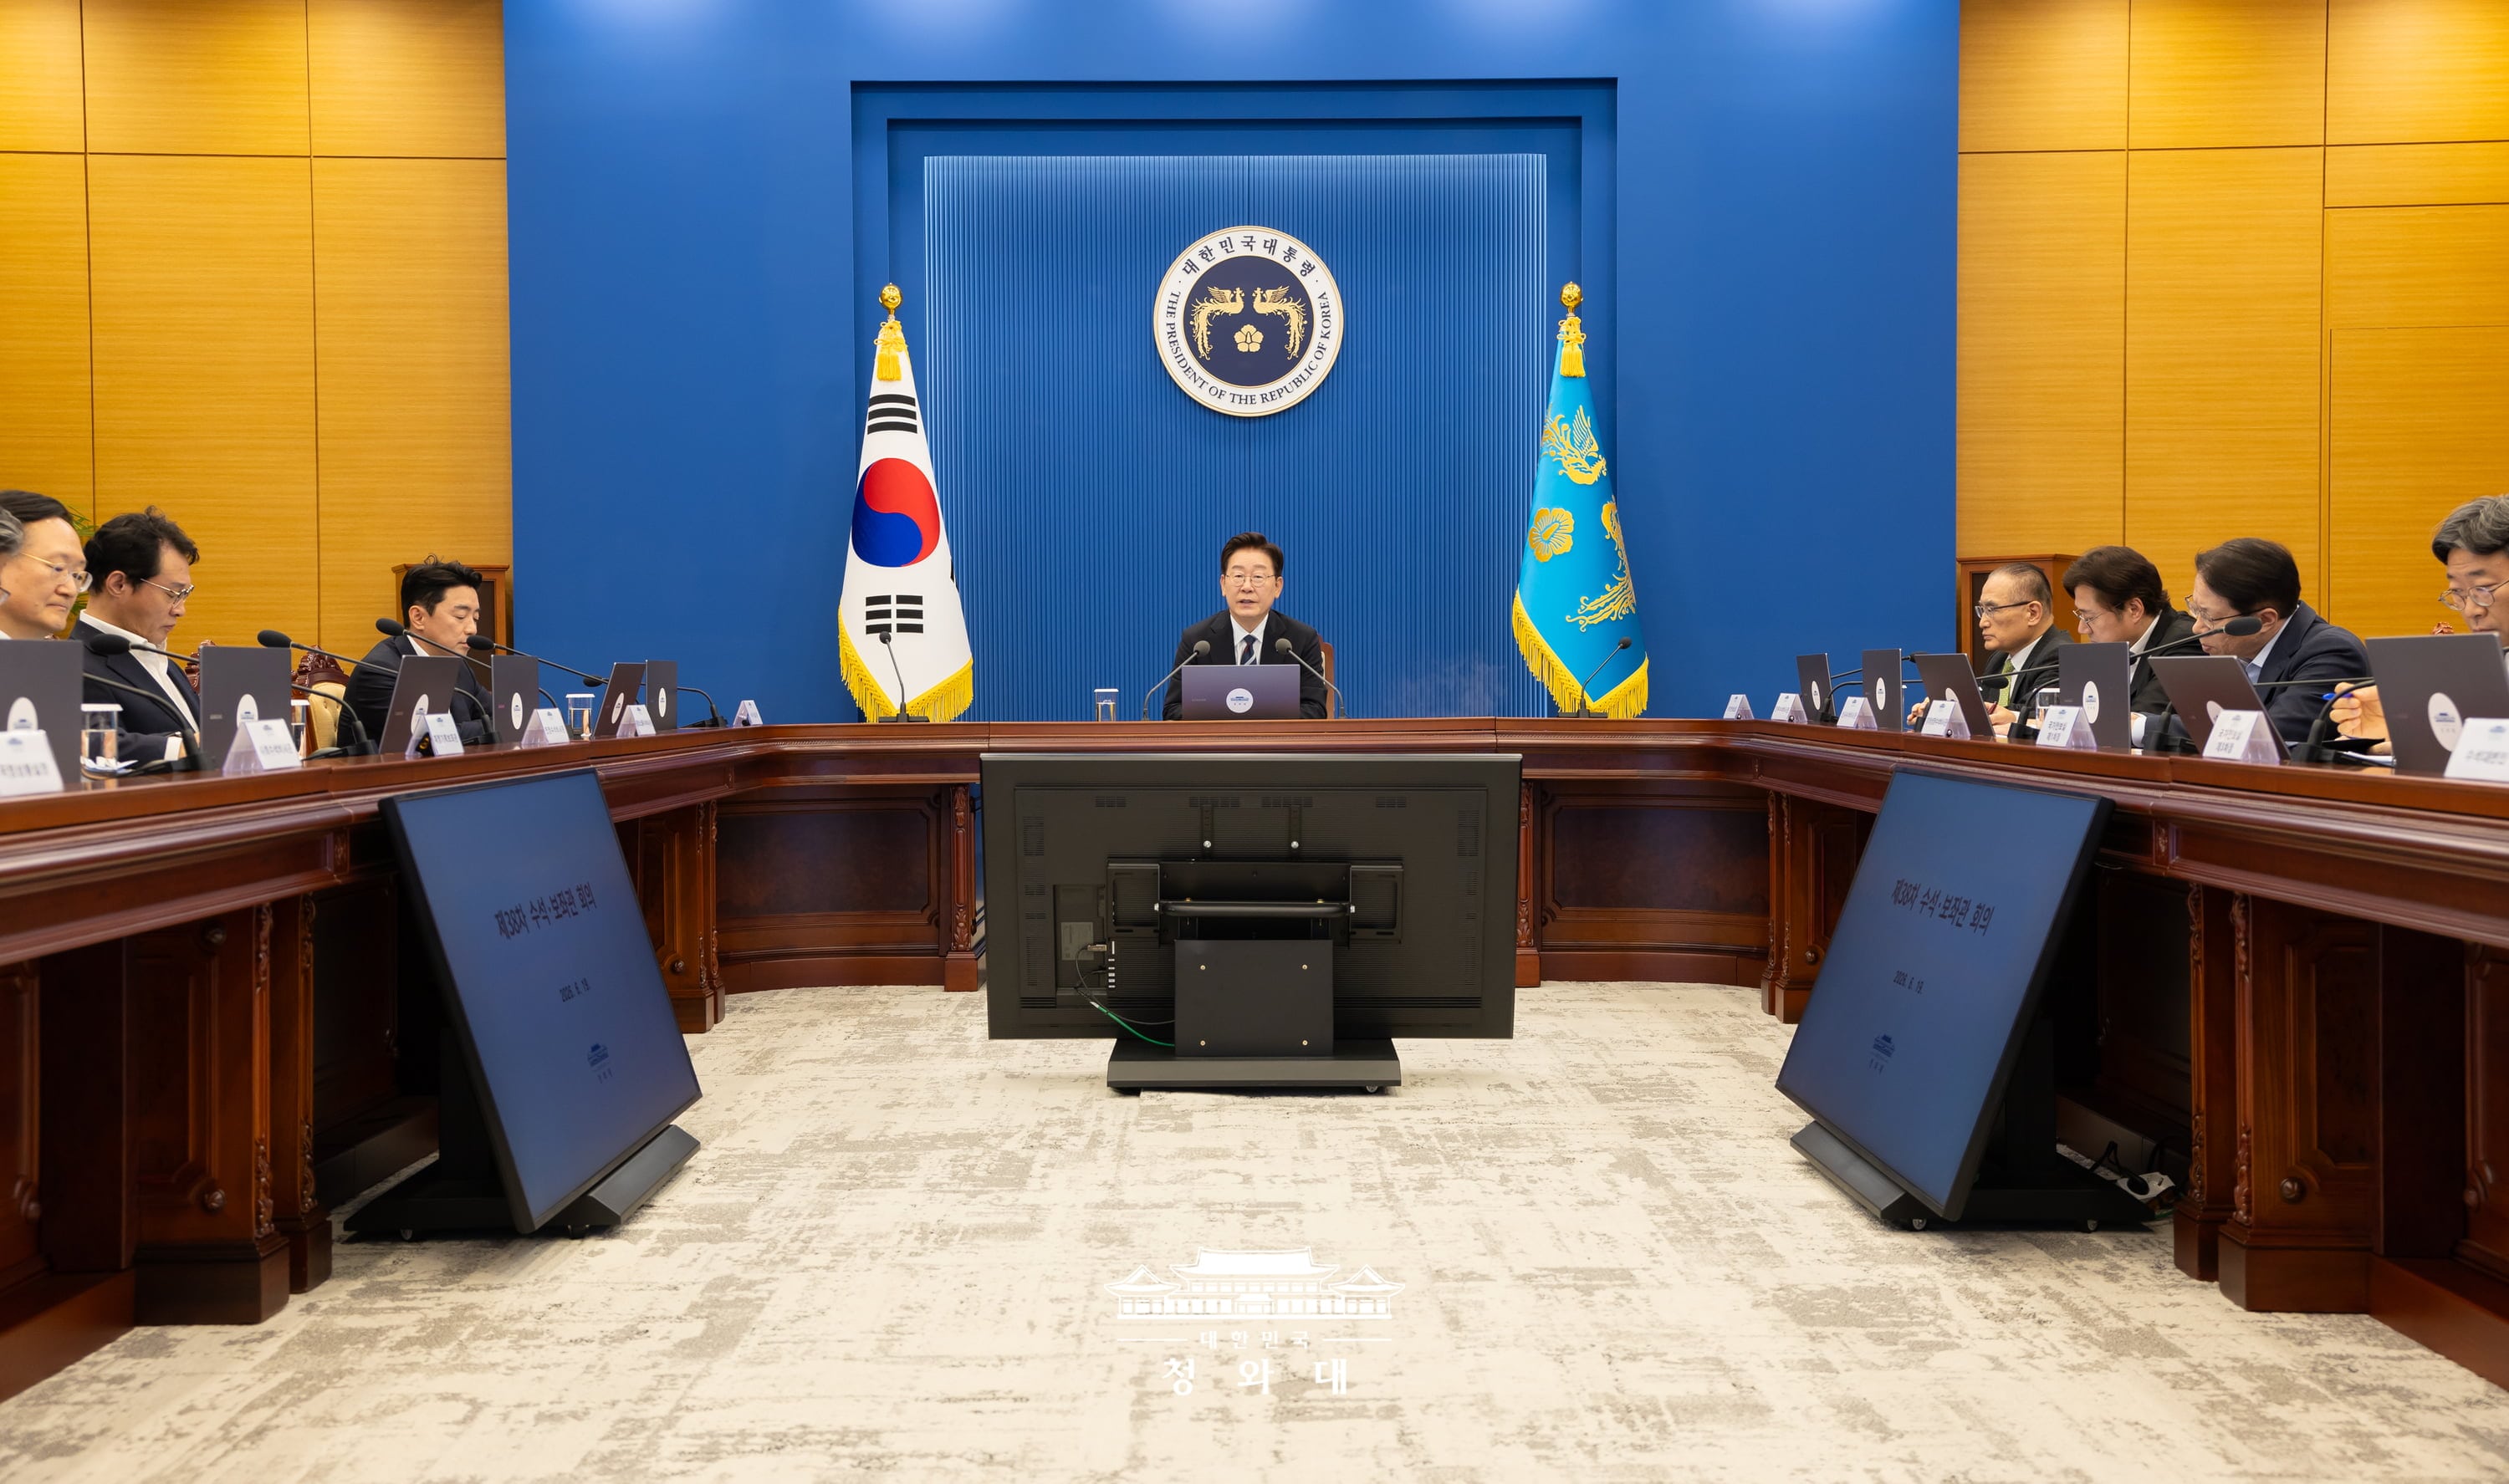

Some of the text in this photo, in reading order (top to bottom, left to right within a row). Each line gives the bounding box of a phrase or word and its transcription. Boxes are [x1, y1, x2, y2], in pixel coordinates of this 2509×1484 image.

[1166, 289, 1331, 405] THE PRESIDENT OF THE REPUBLIC OF KOREA
[494, 903, 530, 940] 제38차
[576, 881, 597, 911] 회의
[1891, 879, 1921, 910] 제38차
[1970, 902, 1995, 936] 회의
